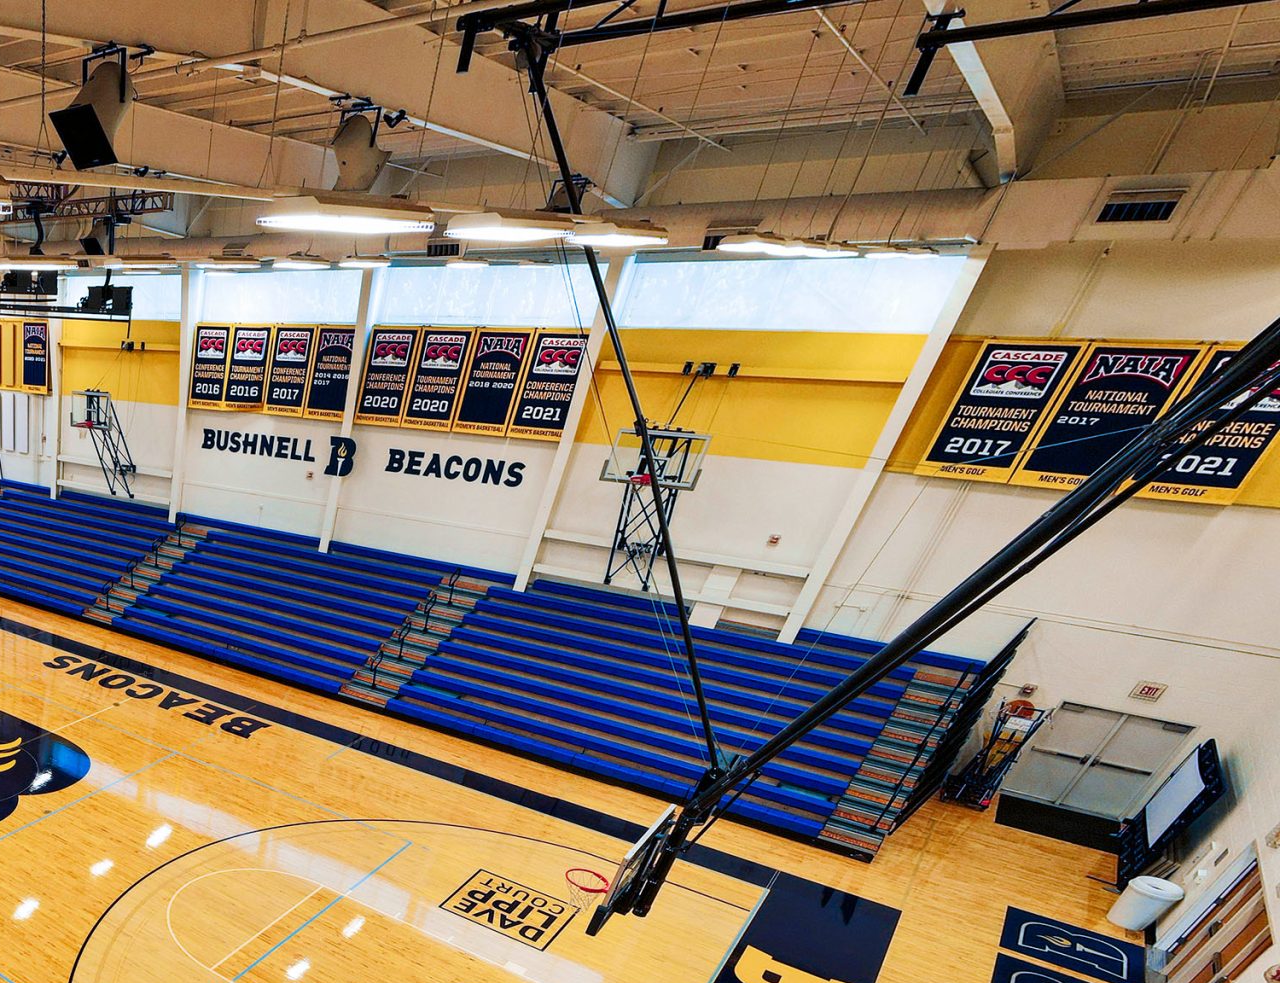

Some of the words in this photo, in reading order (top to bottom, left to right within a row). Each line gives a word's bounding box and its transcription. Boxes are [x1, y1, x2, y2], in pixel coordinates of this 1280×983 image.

[24, 325, 46, 341] NAIA
[200, 338, 224, 350] CCC
[237, 339, 264, 351] CCC
[279, 340, 307, 352] CCC
[320, 332, 355, 351] NAIA
[376, 343, 409, 356] CCC
[427, 345, 461, 359] CCC
[478, 337, 524, 359] NAIA
[322, 355, 347, 363] NATIONAL
[540, 349, 582, 363] CCC
[991, 352, 1065, 361] CASCADE
[195, 364, 225, 372] CONFERENCE
[231, 366, 264, 374] TOURNAMENT
[273, 367, 306, 375] CONFERENCE
[481, 362, 511, 371] NATIONAL
[1084, 354, 1184, 387] NAIA
[194, 371, 224, 379] CHAMPIONS
[272, 375, 304, 384] CHAMPIONS
[368, 373, 406, 382] CONFERENCE
[473, 370, 516, 380] TOURNAMENT
[983, 364, 1055, 383] CCC
[366, 381, 404, 391] CHAMPIONS
[417, 375, 457, 385] TOURNAMENT
[195, 383, 220, 395] 2016
[230, 385, 259, 397] 2016
[414, 384, 455, 394] CHAMPIONS
[526, 381, 575, 392] CONFERENCE
[272, 388, 299, 400] 2017
[524, 390, 572, 402] CHAMPIONS
[1085, 390, 1150, 403] NATIONAL
[364, 395, 398, 408] 2020
[412, 399, 448, 412] 2020
[522, 405, 561, 421] 2021
[958, 405, 1037, 420] TOURNAMENT
[1068, 401, 1156, 416] TOURNAMENT
[950, 417, 1031, 433] CHAMPIONS
[1056, 415, 1100, 426] 2017
[476, 425, 503, 433] BASKETBALL
[944, 436, 1012, 457] 2017
[202, 428, 315, 462] BUSHNELL
[385, 448, 526, 488] BEACONS
[940, 465, 965, 474] MEN'S
[966, 468, 987, 476] GOLF
[1038, 474, 1066, 484] MEN'S
[1148, 485, 1181, 495] MEN'S
[1181, 488, 1208, 497] GOLF
[43, 656, 272, 739] BEACONS
[480, 878, 565, 915] COURT
[467, 889, 558, 930] LIPP
[453, 897, 546, 943] DAVE
